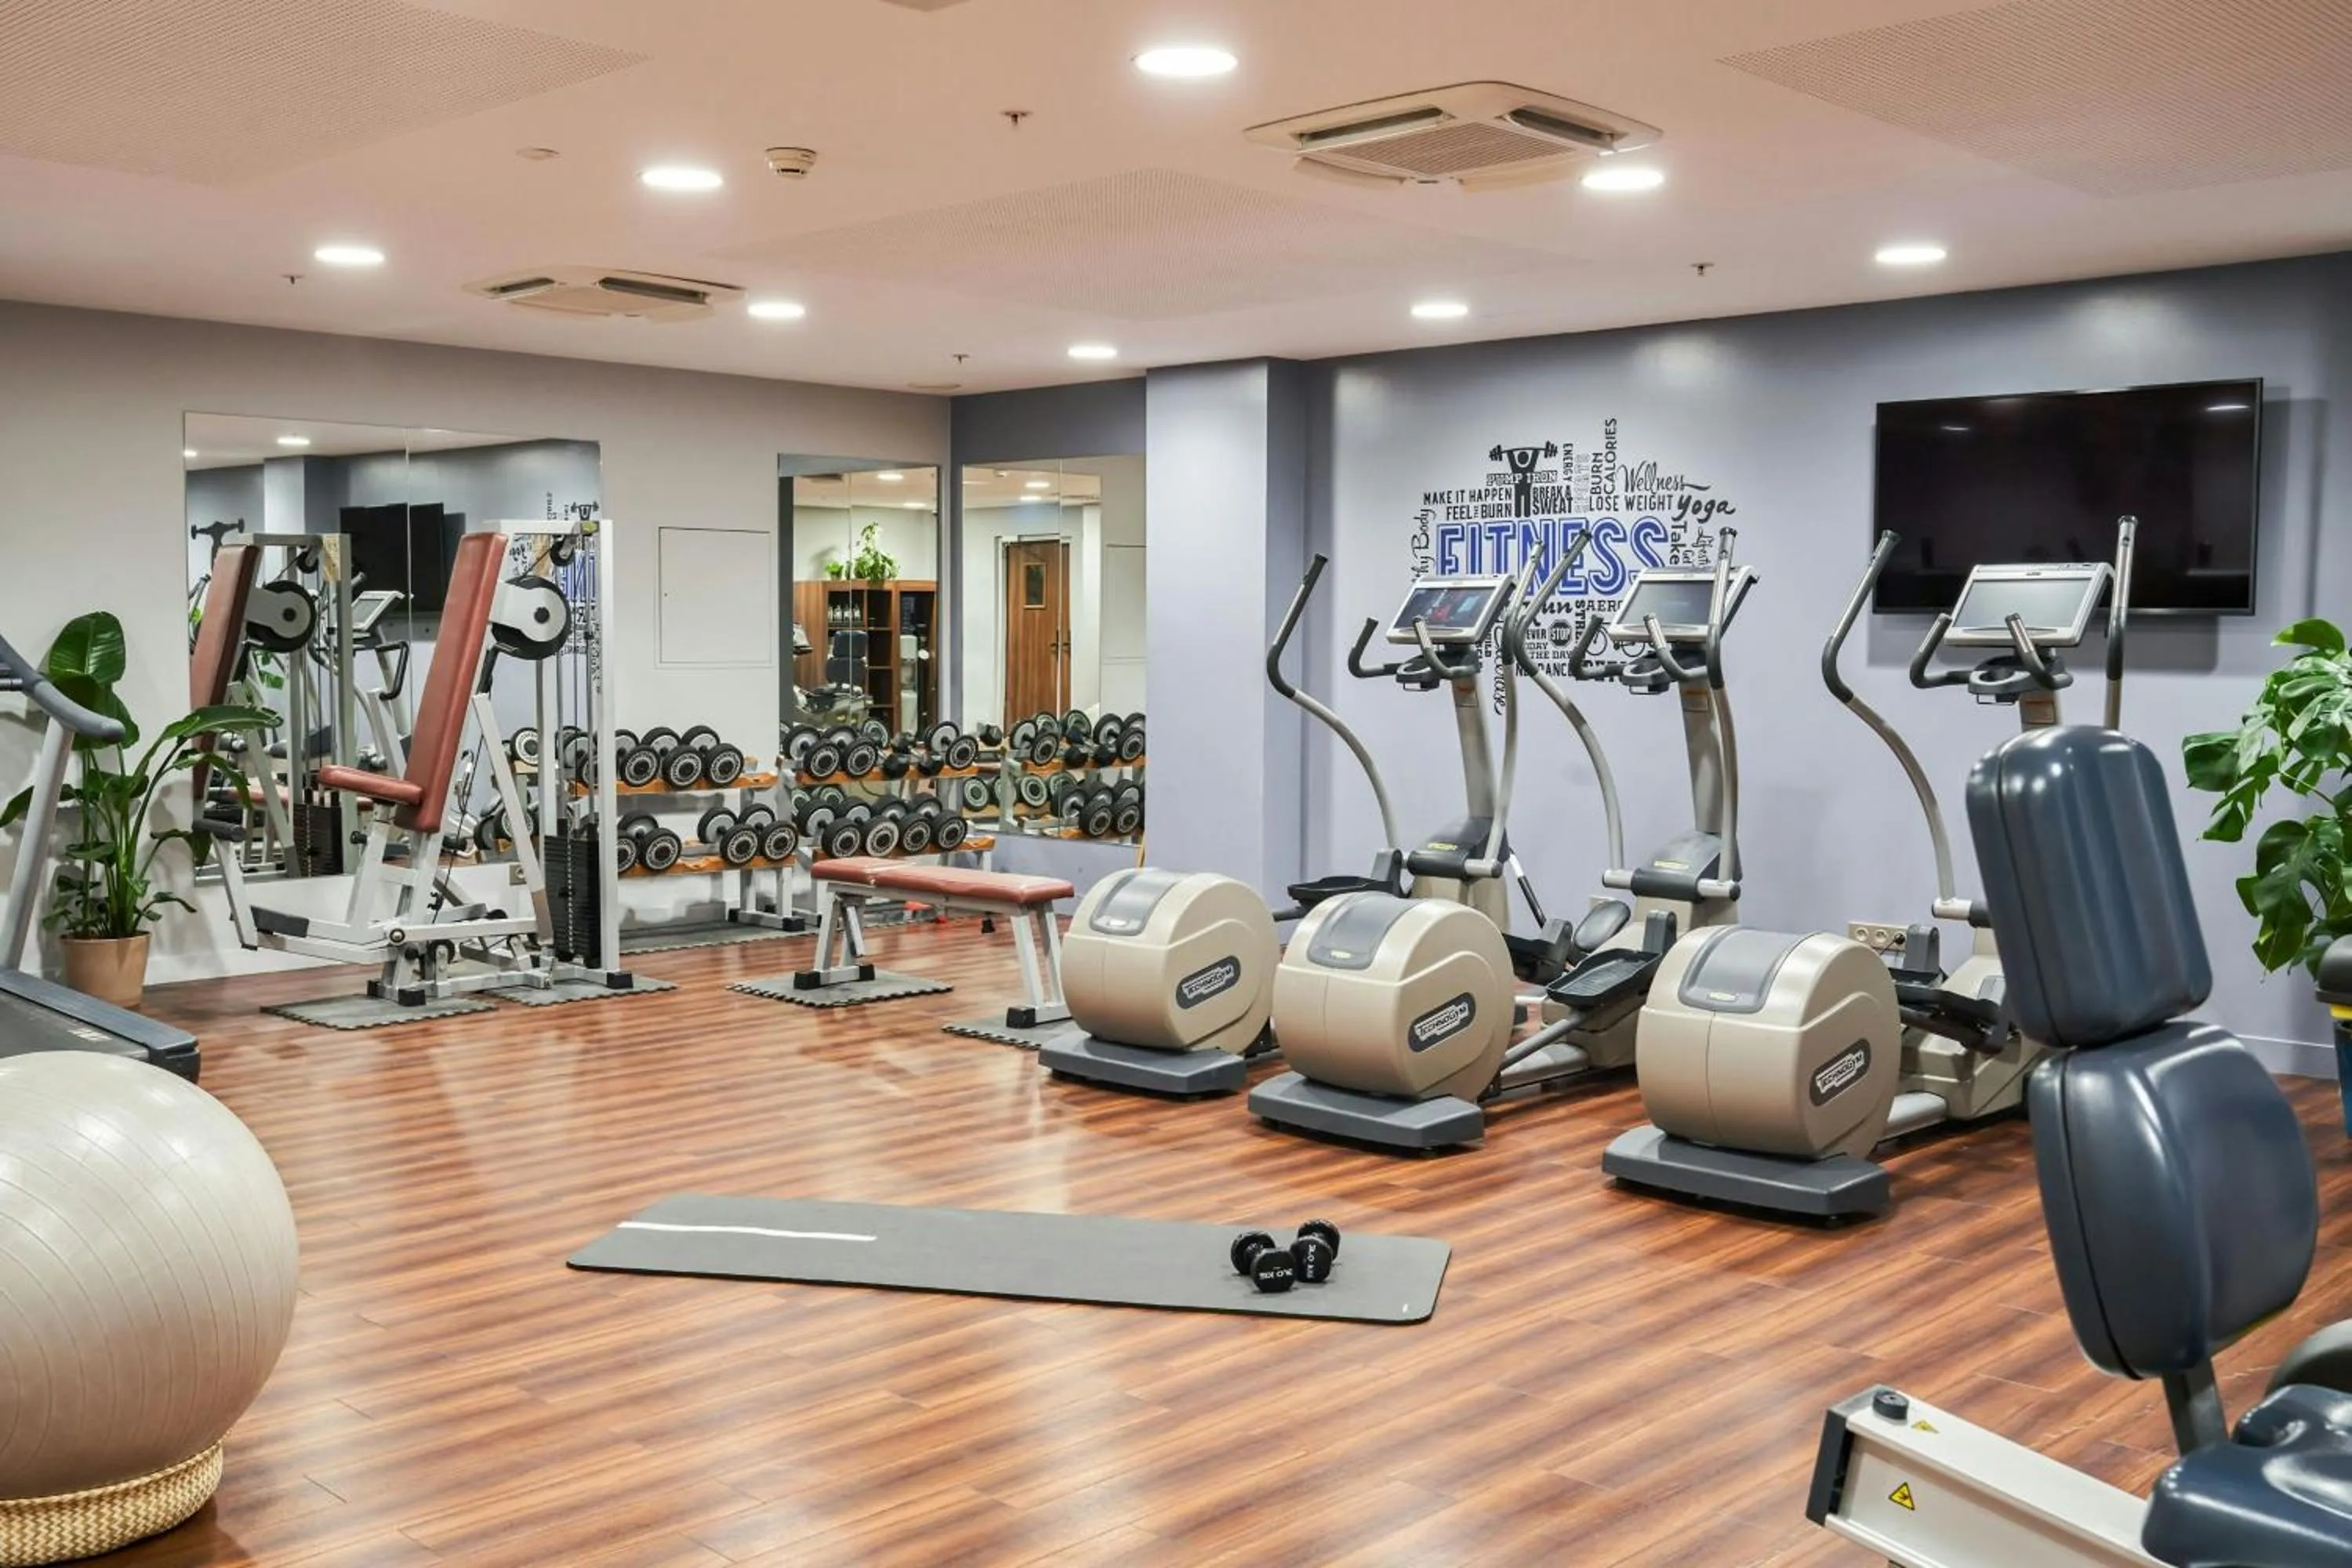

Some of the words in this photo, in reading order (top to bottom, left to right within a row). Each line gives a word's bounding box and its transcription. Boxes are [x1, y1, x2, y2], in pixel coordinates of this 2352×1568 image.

[1563, 443, 1573, 481] ENERGY
[1603, 417, 1617, 495] CALORIES
[1486, 473, 1522, 486] PUMP
[1526, 470, 1558, 484] IRON
[1590, 452, 1602, 495] BURN
[1617, 460, 1711, 495] Wellness
[1423, 490, 1453, 505] MAKE
[1456, 489, 1465, 503] IT
[1469, 486, 1512, 503] HAPPEN
[1532, 486, 1563, 500] BREAK
[1532, 497, 1573, 514] SWEAT
[1589, 495, 1620, 512] LOSE
[1624, 494, 1674, 511] WEIGHT
[1446, 505, 1473, 521] FEEL
[1481, 503, 1512, 519] BURN
[1411, 509, 1436, 558] Body
[1669, 521, 1687, 565] Take
[1436, 515, 1669, 597] FITNESS
[1551, 628, 1570, 641] STOP
